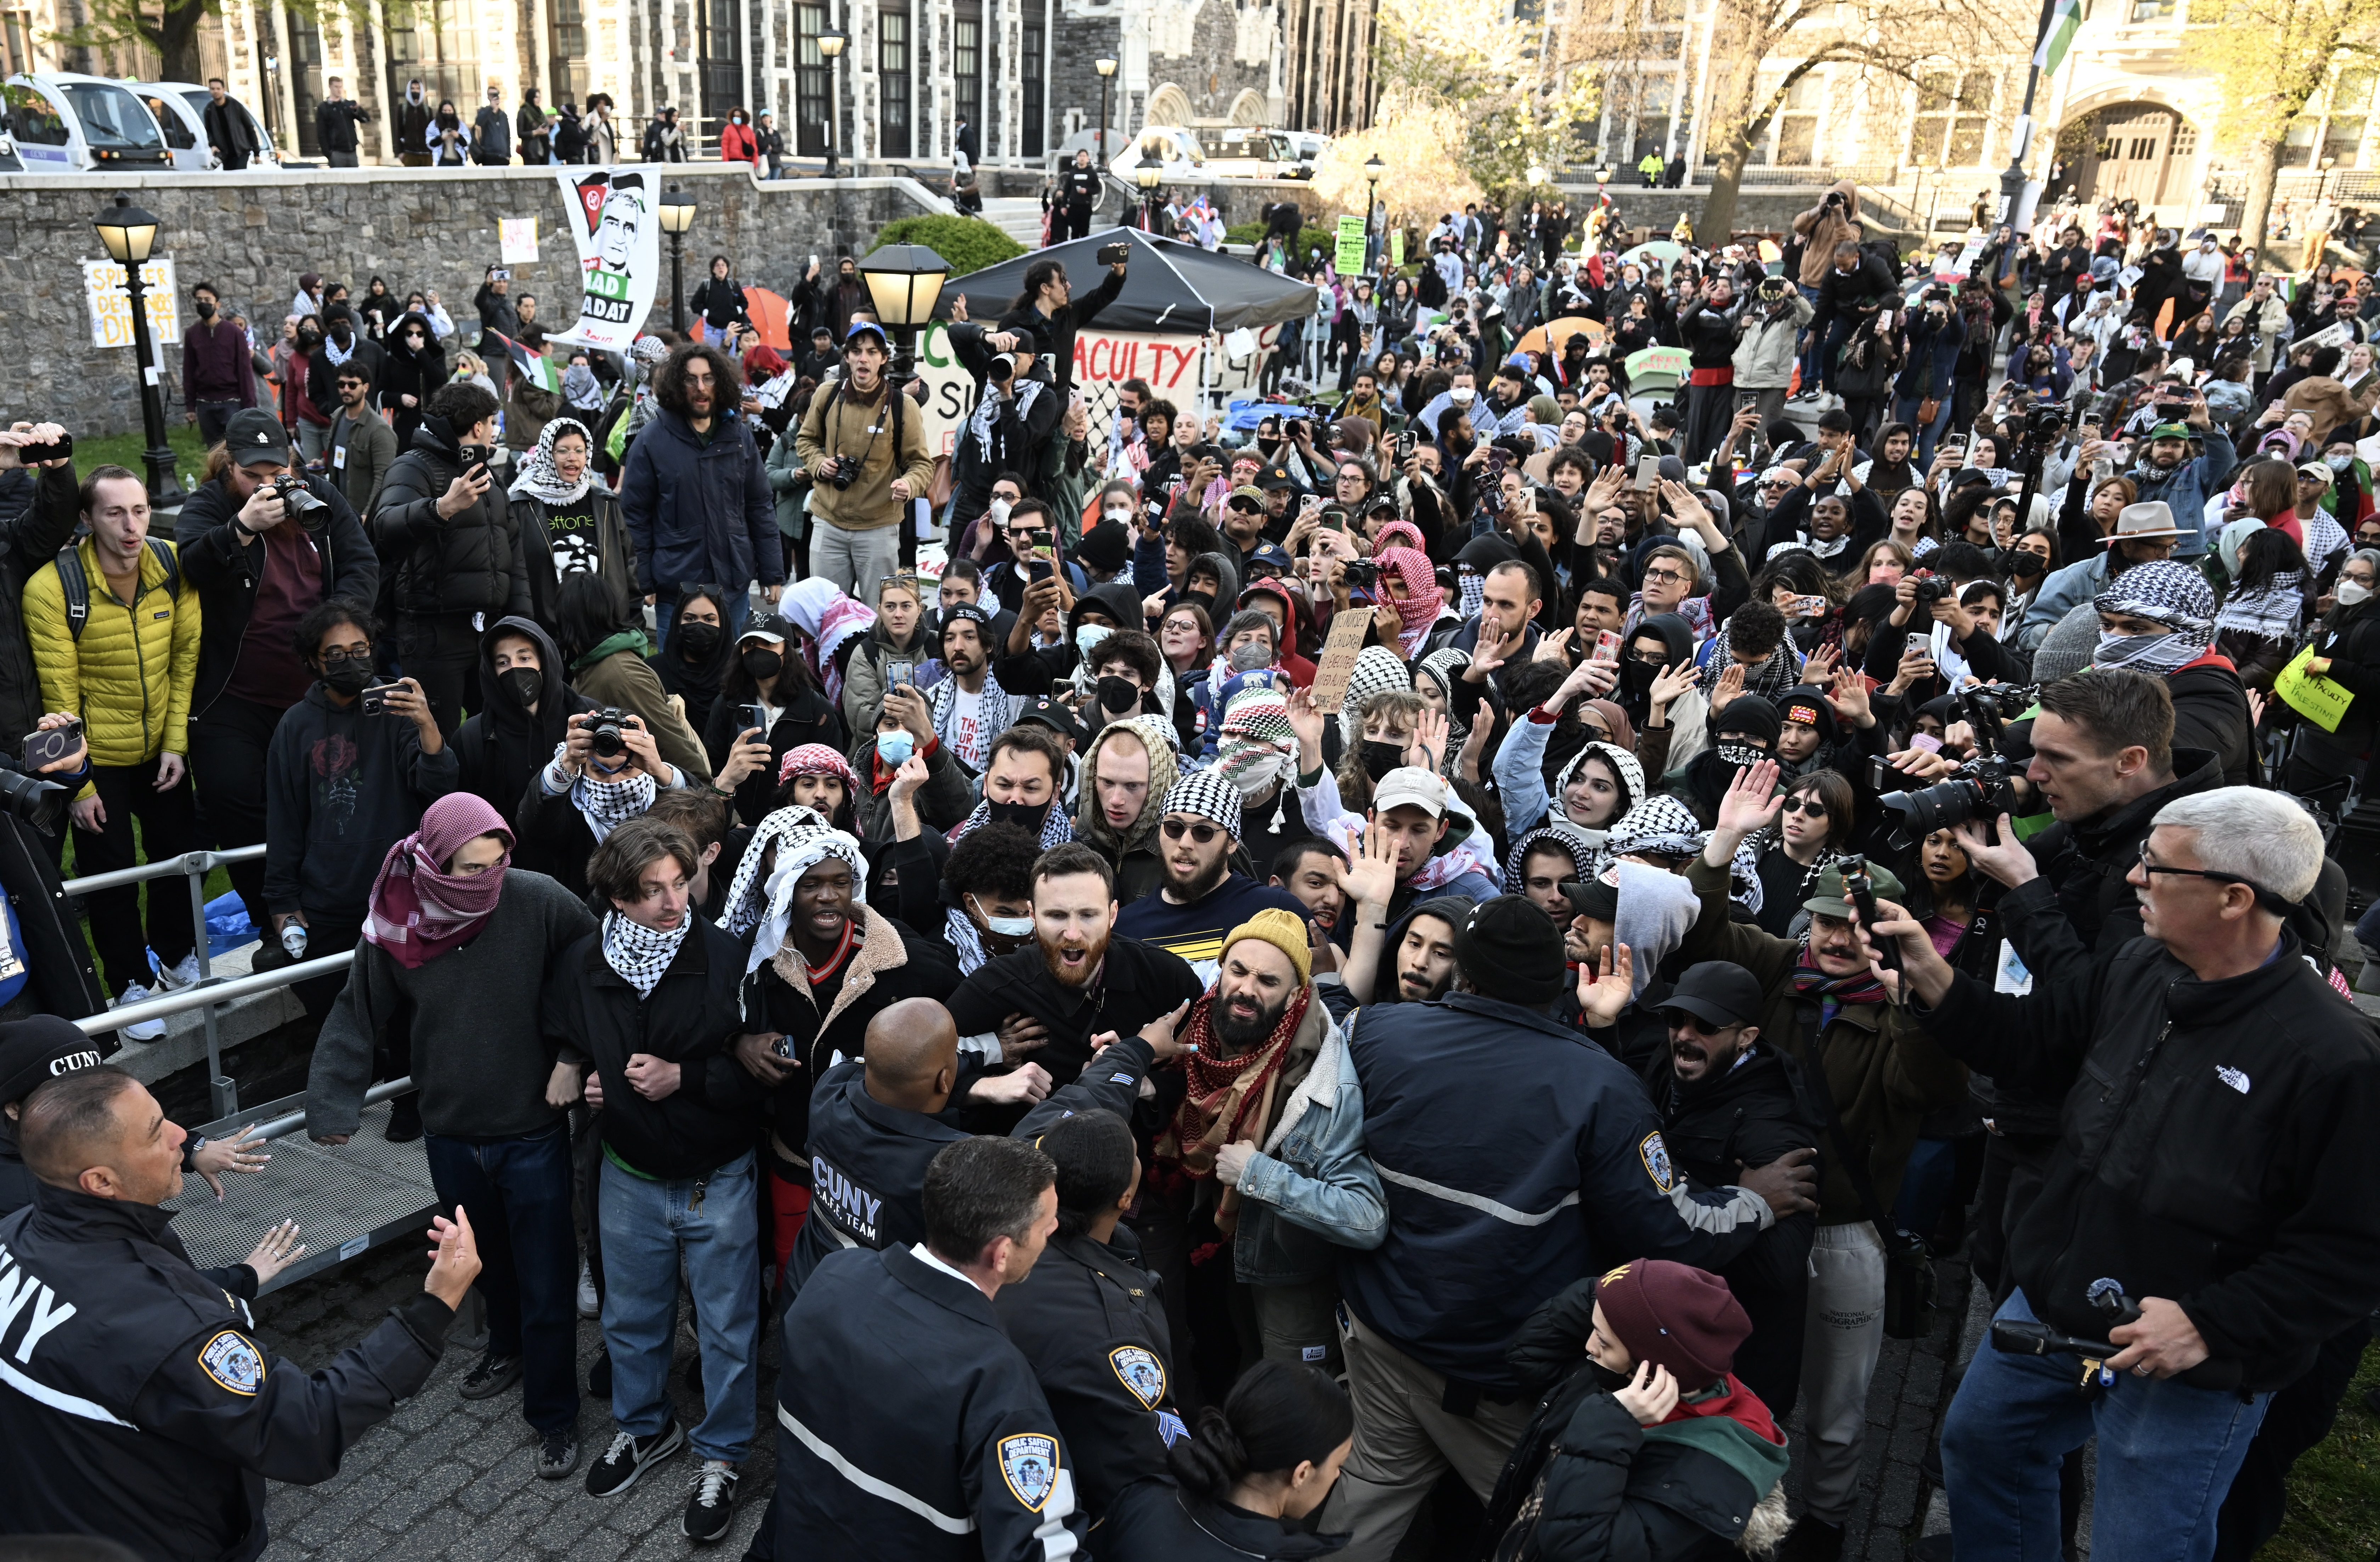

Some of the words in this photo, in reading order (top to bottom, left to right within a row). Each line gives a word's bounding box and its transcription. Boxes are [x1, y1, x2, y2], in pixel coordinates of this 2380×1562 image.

[92, 267, 168, 290] SPIER
[97, 293, 173, 313] DEMNDS
[581, 295, 629, 321] ADAT
[103, 313, 175, 345] DIVST
[1073, 336, 1197, 388] ACULTY
[1650, 354, 1681, 364] FREE
[937, 381, 971, 419] SI
[548, 515, 594, 530] eftone
[1343, 611, 1368, 628] NURSES
[1334, 633, 1362, 649] CHILDREN
[1327, 653, 1354, 669] EXECUTED
[1331, 673, 1349, 687] ALIVE
[1332, 690, 1343, 700] ACT
[2314, 677, 2347, 705] FACULTY
[2291, 681, 2337, 723] PALESTINE
[959, 732, 973, 746] UR
[1718, 745, 1764, 759] DEFEAT
[1718, 751, 1758, 765] FASCISM
[50, 1051, 101, 1076] CUNY
[2230, 1066, 2242, 1076] THE
[2215, 1065, 2239, 1082] NORTH
[2218, 1074, 2235, 1087] FACE
[813, 1156, 881, 1225] CUNY
[815, 1183, 842, 1220] S.A.F.E.
[846, 1212, 876, 1240] TEAM
[1819, 1313, 1873, 1325] GEOGRAPHIC
[204, 1342, 221, 1363] PUBLIC
[211, 1339, 242, 1367] DEPARTMENT
[248, 1348, 259, 1363] YORK
[1115, 1349, 1132, 1362] PUBLIC
[1132, 1349, 1151, 1358] SAFETY
[1120, 1355, 1152, 1367] DEPARTMENT
[213, 1369, 225, 1380] CITY
[224, 1378, 256, 1392] UNIVERSITY
[1119, 1369, 1129, 1380] CITY
[1127, 1380, 1151, 1404] UNIVERSITY
[1005, 1437, 1027, 1451] PUBLIC
[1028, 1437, 1051, 1450] SAFETY
[1009, 1445, 1050, 1459] DEPARTMENT
[1004, 1460, 1012, 1474] CITY
[1009, 1475, 1035, 1505] UNIVERSITY
[1040, 1484, 1050, 1498] NEW
[1047, 1466, 1055, 1483] YORK
